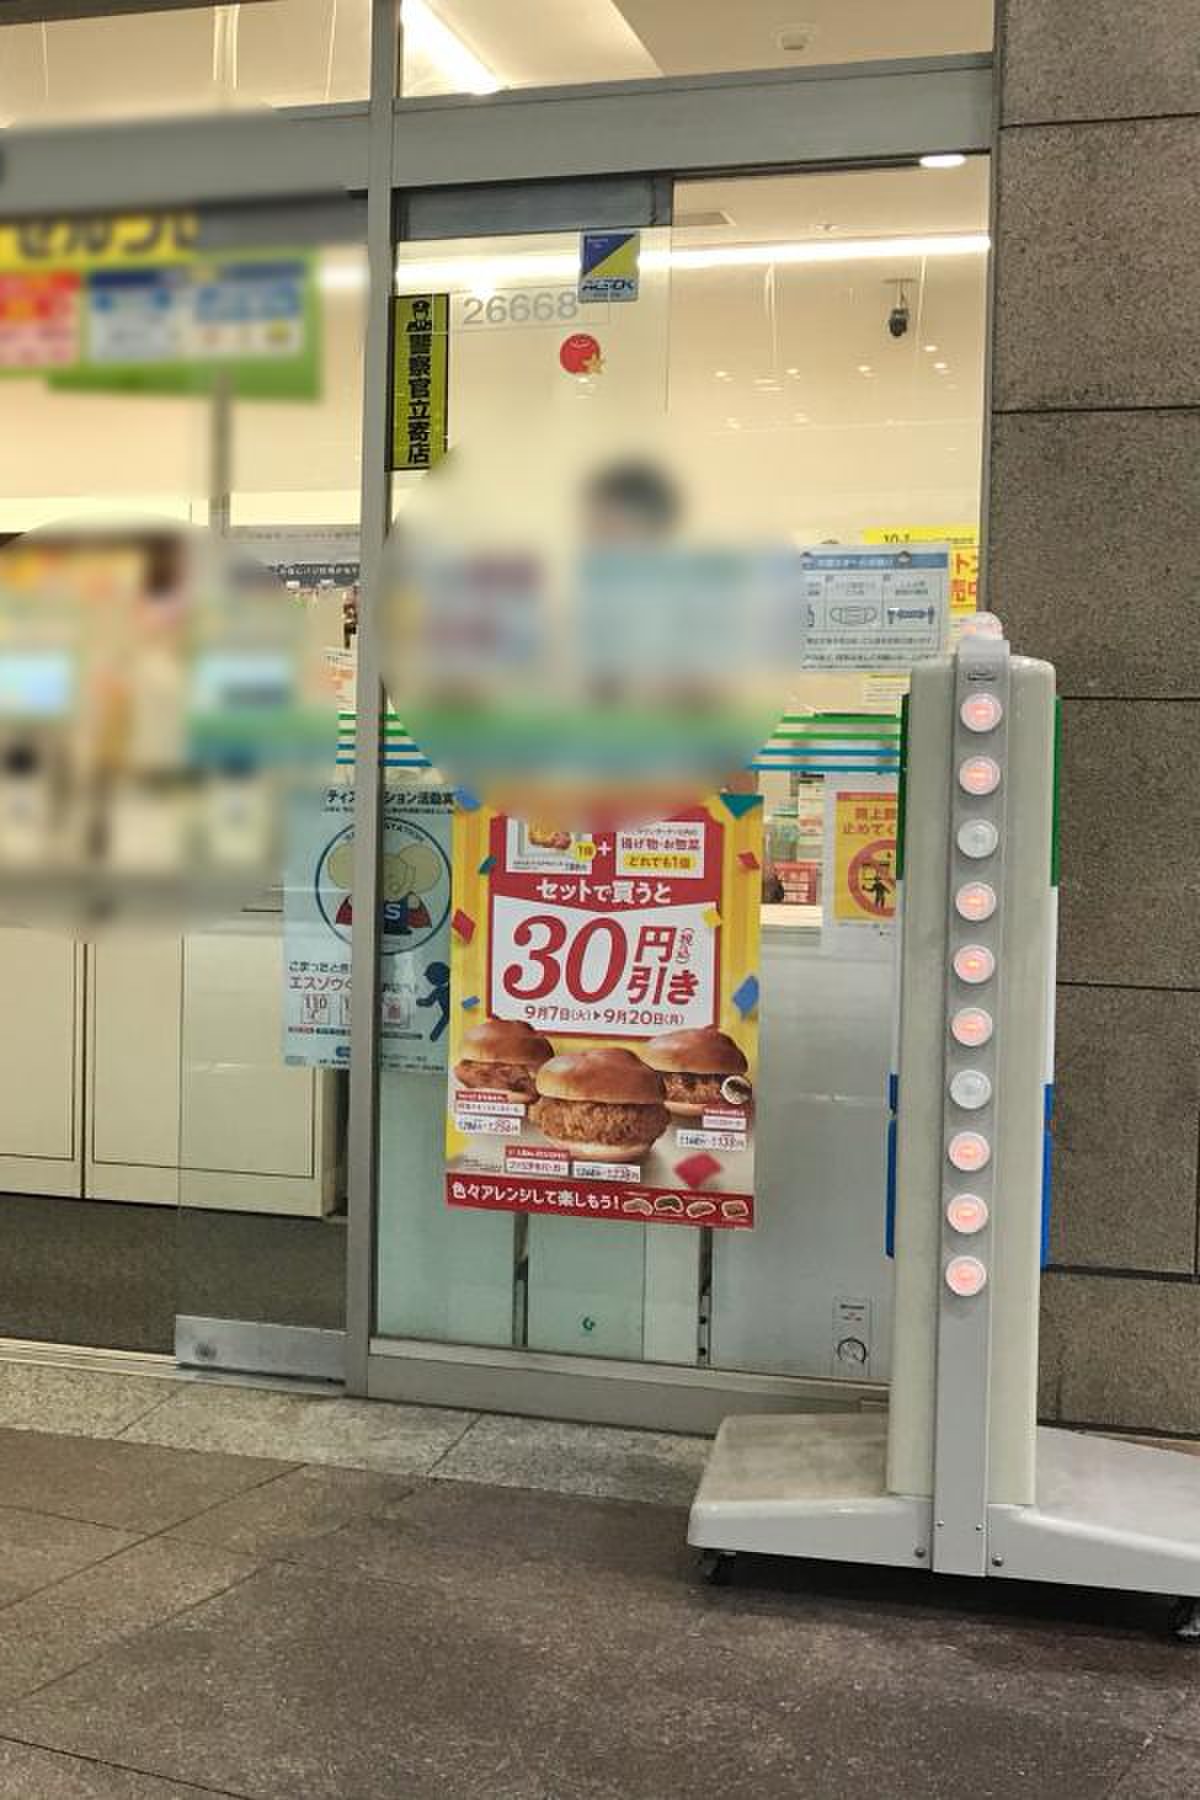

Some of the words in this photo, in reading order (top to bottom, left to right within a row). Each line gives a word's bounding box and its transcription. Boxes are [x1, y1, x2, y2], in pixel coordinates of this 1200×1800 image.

[463, 292, 579, 325] 26668
[536, 879, 672, 904] セットで買うと
[502, 914, 629, 1003] 30
